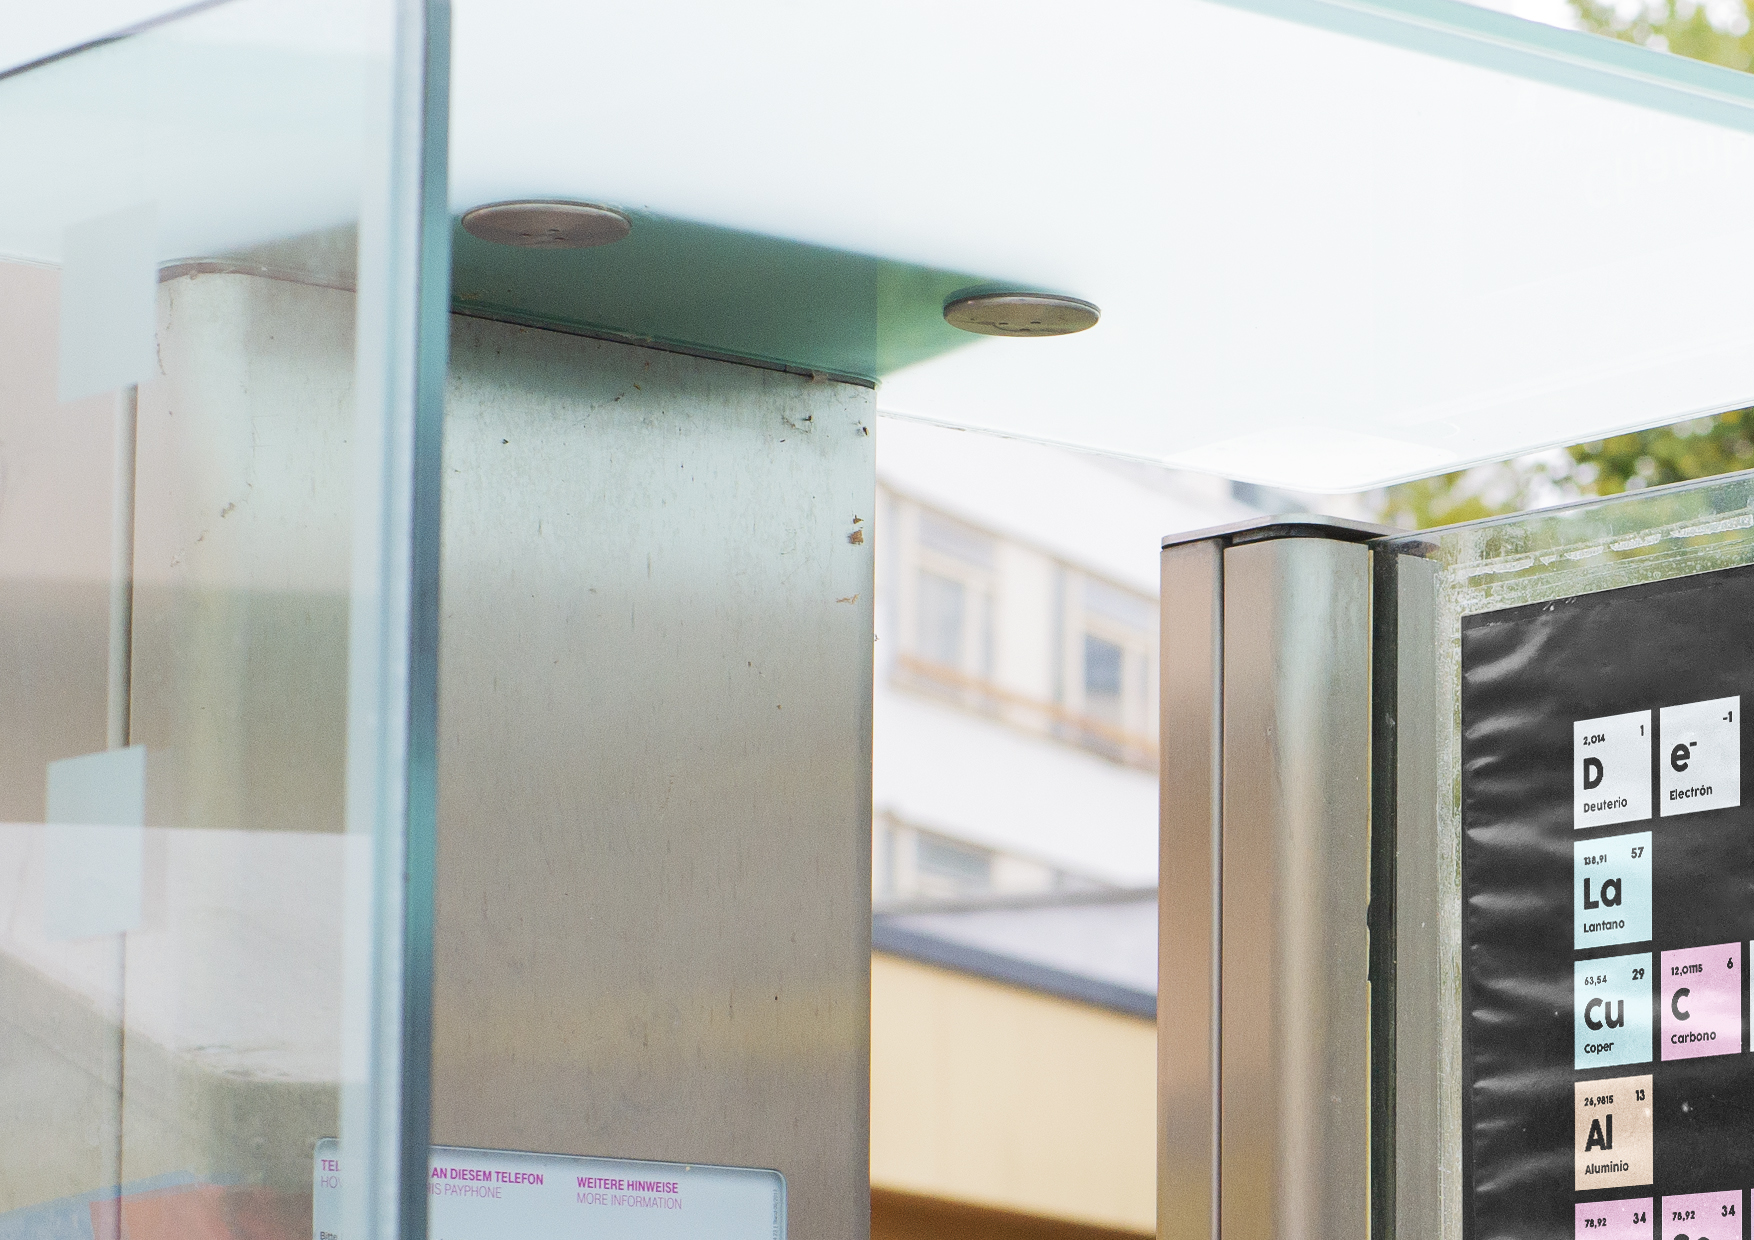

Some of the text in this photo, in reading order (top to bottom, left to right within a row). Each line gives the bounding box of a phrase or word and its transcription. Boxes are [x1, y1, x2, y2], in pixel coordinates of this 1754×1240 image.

[1584, 734, 1605, 746] 2,014
[1584, 757, 1603, 790] D
[1670, 785, 1712, 800] Electrón
[1584, 799, 1627, 813] Deuterio
[1631, 847, 1644, 858] 57
[1584, 878, 1621, 910] La
[1584, 920, 1624, 933] Lantano
[1585, 975, 1607, 986] 63,54
[1632, 968, 1644, 980] 29
[1672, 988, 1690, 1021] C
[1584, 998, 1624, 1031] Cu
[1671, 1032, 1716, 1044] Carbono
[1584, 1043, 1614, 1054] Coper
[1584, 1095, 1613, 1107] 26,9815
[1636, 1089, 1645, 1101] 13
[1585, 1114, 1612, 1152] Al
[1585, 1160, 1629, 1175] Aluminio
[432, 1167, 544, 1185] AN DIESEM TELEFON
[444, 1184, 502, 1198] PAYPHONE
[577, 1177, 679, 1193] WEITERE HINWEISE
[577, 1193, 682, 1209] MORE INFORMATION
[1673, 1211, 1695, 1221] 78,92
[1722, 1205, 1735, 1217] 34
[1585, 1218, 1606, 1228] 78,92
[1633, 1212, 1646, 1224] 34
